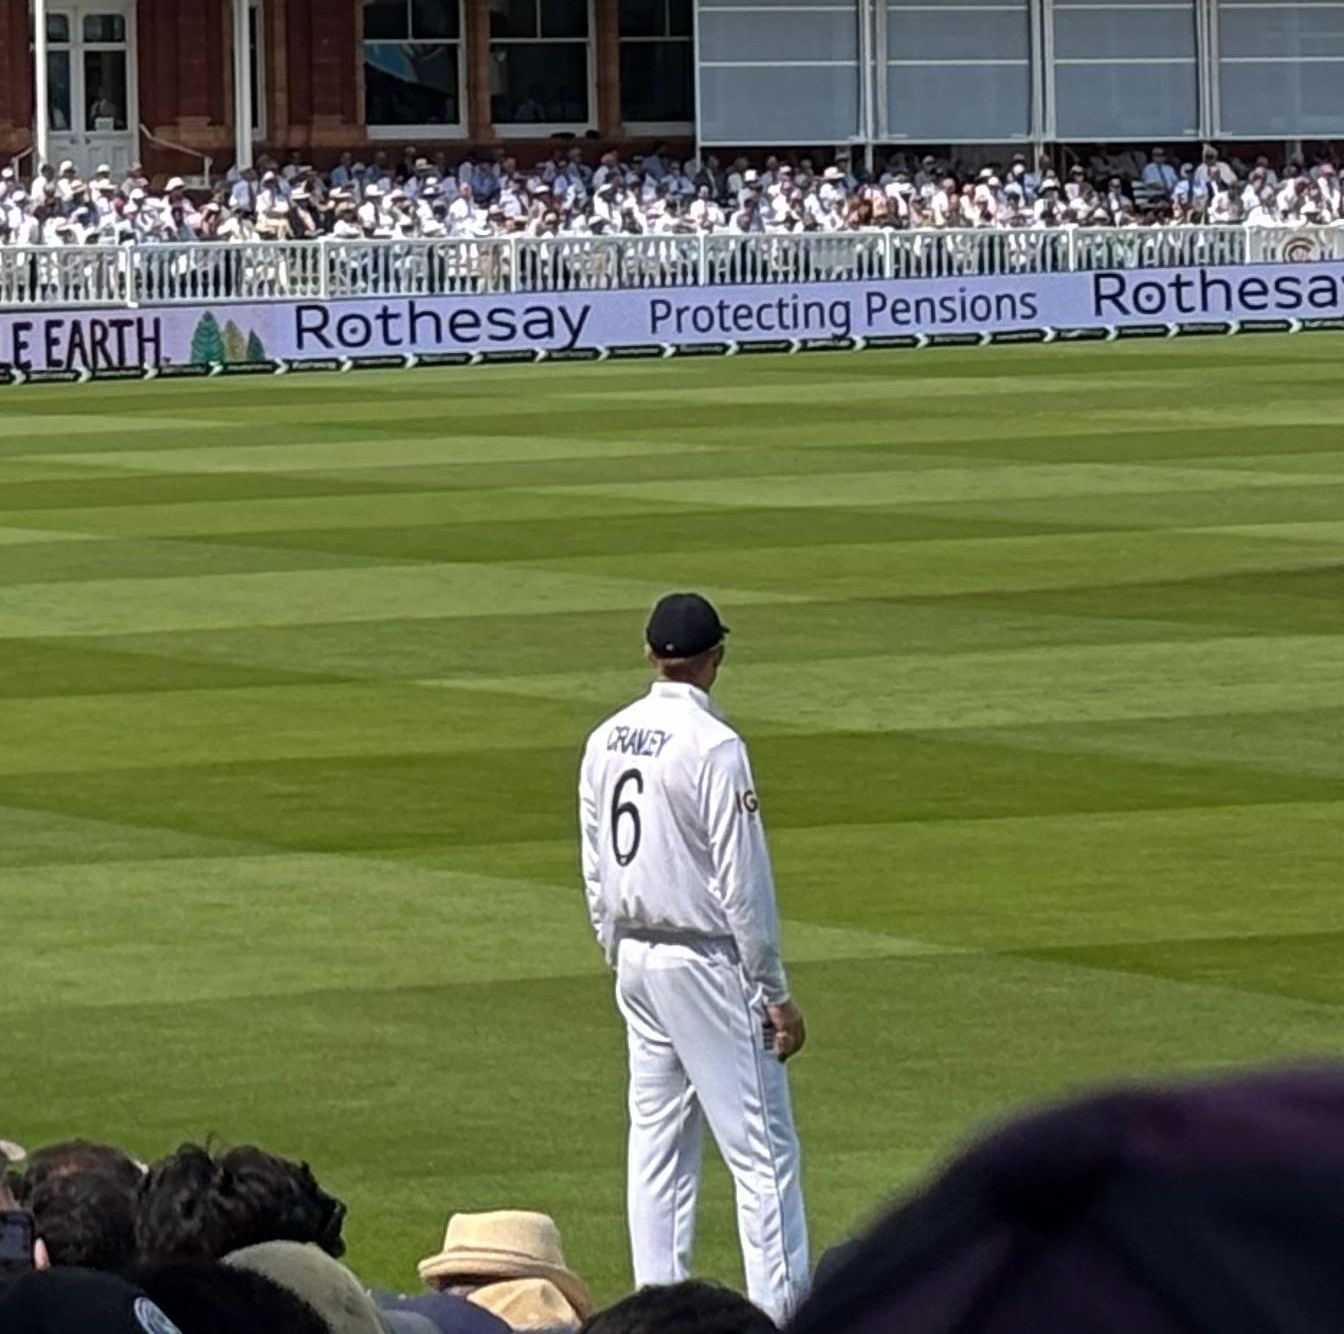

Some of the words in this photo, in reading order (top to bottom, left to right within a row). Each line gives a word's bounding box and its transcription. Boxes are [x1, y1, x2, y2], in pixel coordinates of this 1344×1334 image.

[649, 293, 851, 338] Protecting
[866, 288, 1038, 327] Pensions
[1093, 268, 1344, 316] Rothesa
[45, 317, 161, 371] EARTH
[294, 297, 590, 348] Rothesay
[612, 768, 644, 867] 6
